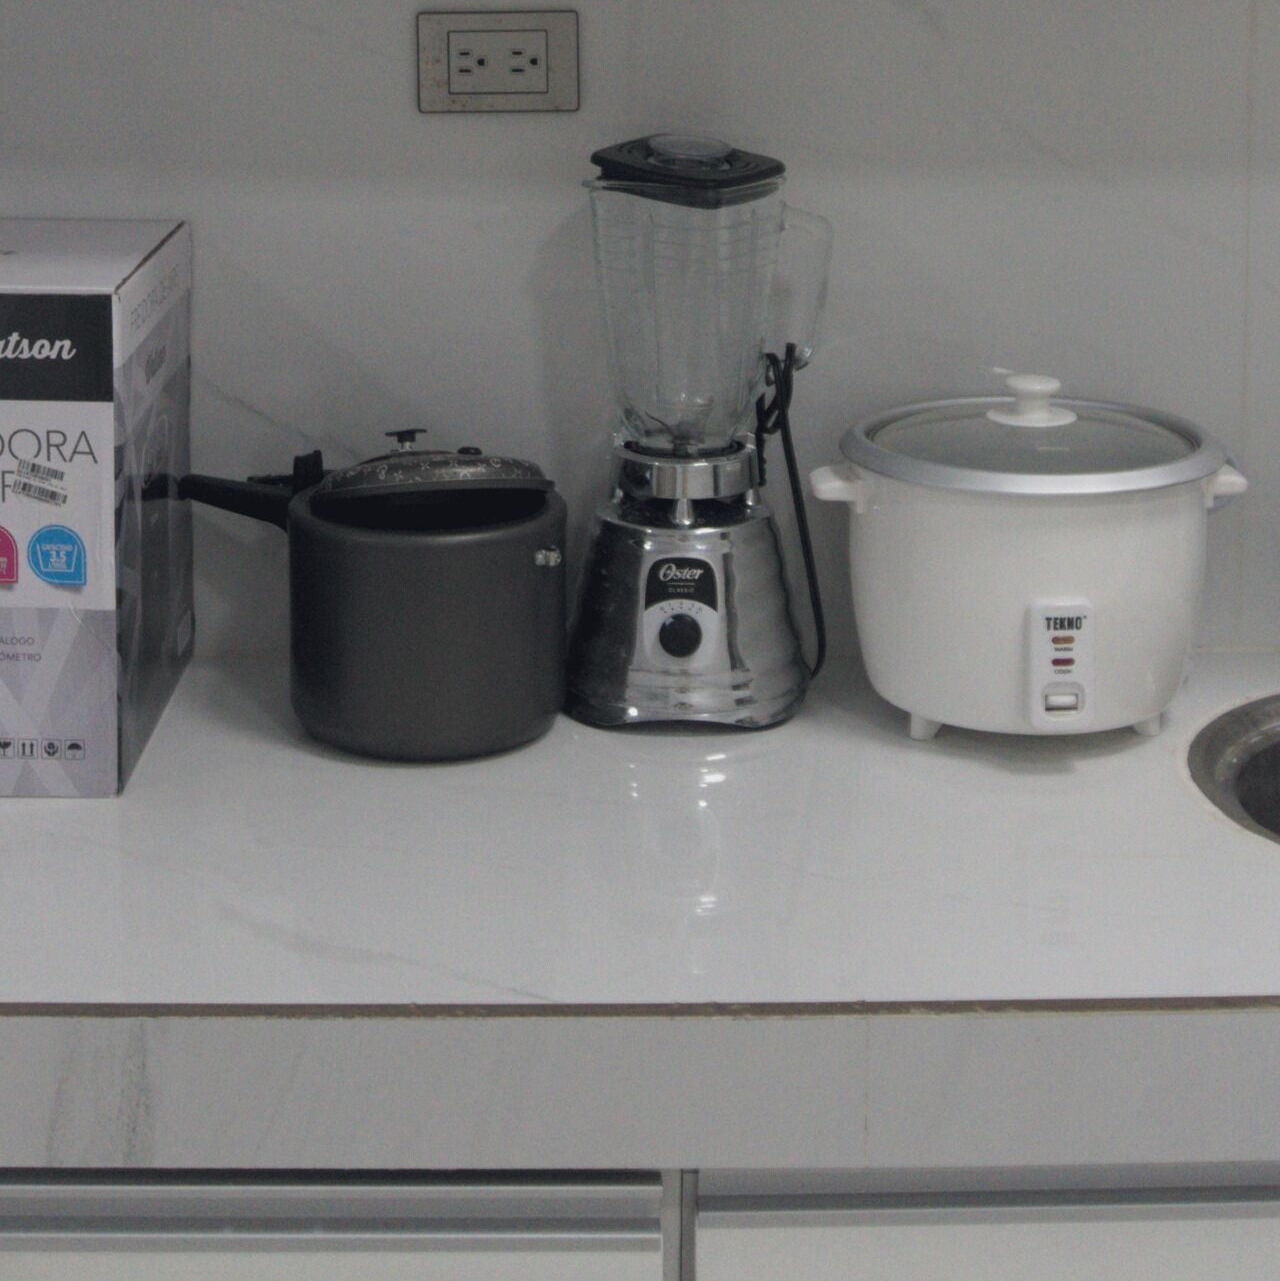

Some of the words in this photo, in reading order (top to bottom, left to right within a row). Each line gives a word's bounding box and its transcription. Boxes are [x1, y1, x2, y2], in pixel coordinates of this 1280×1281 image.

[49, 550, 67, 563] 3.5
[660, 563, 704, 582] Oster
[1045, 616, 1083, 631] TEKNO
